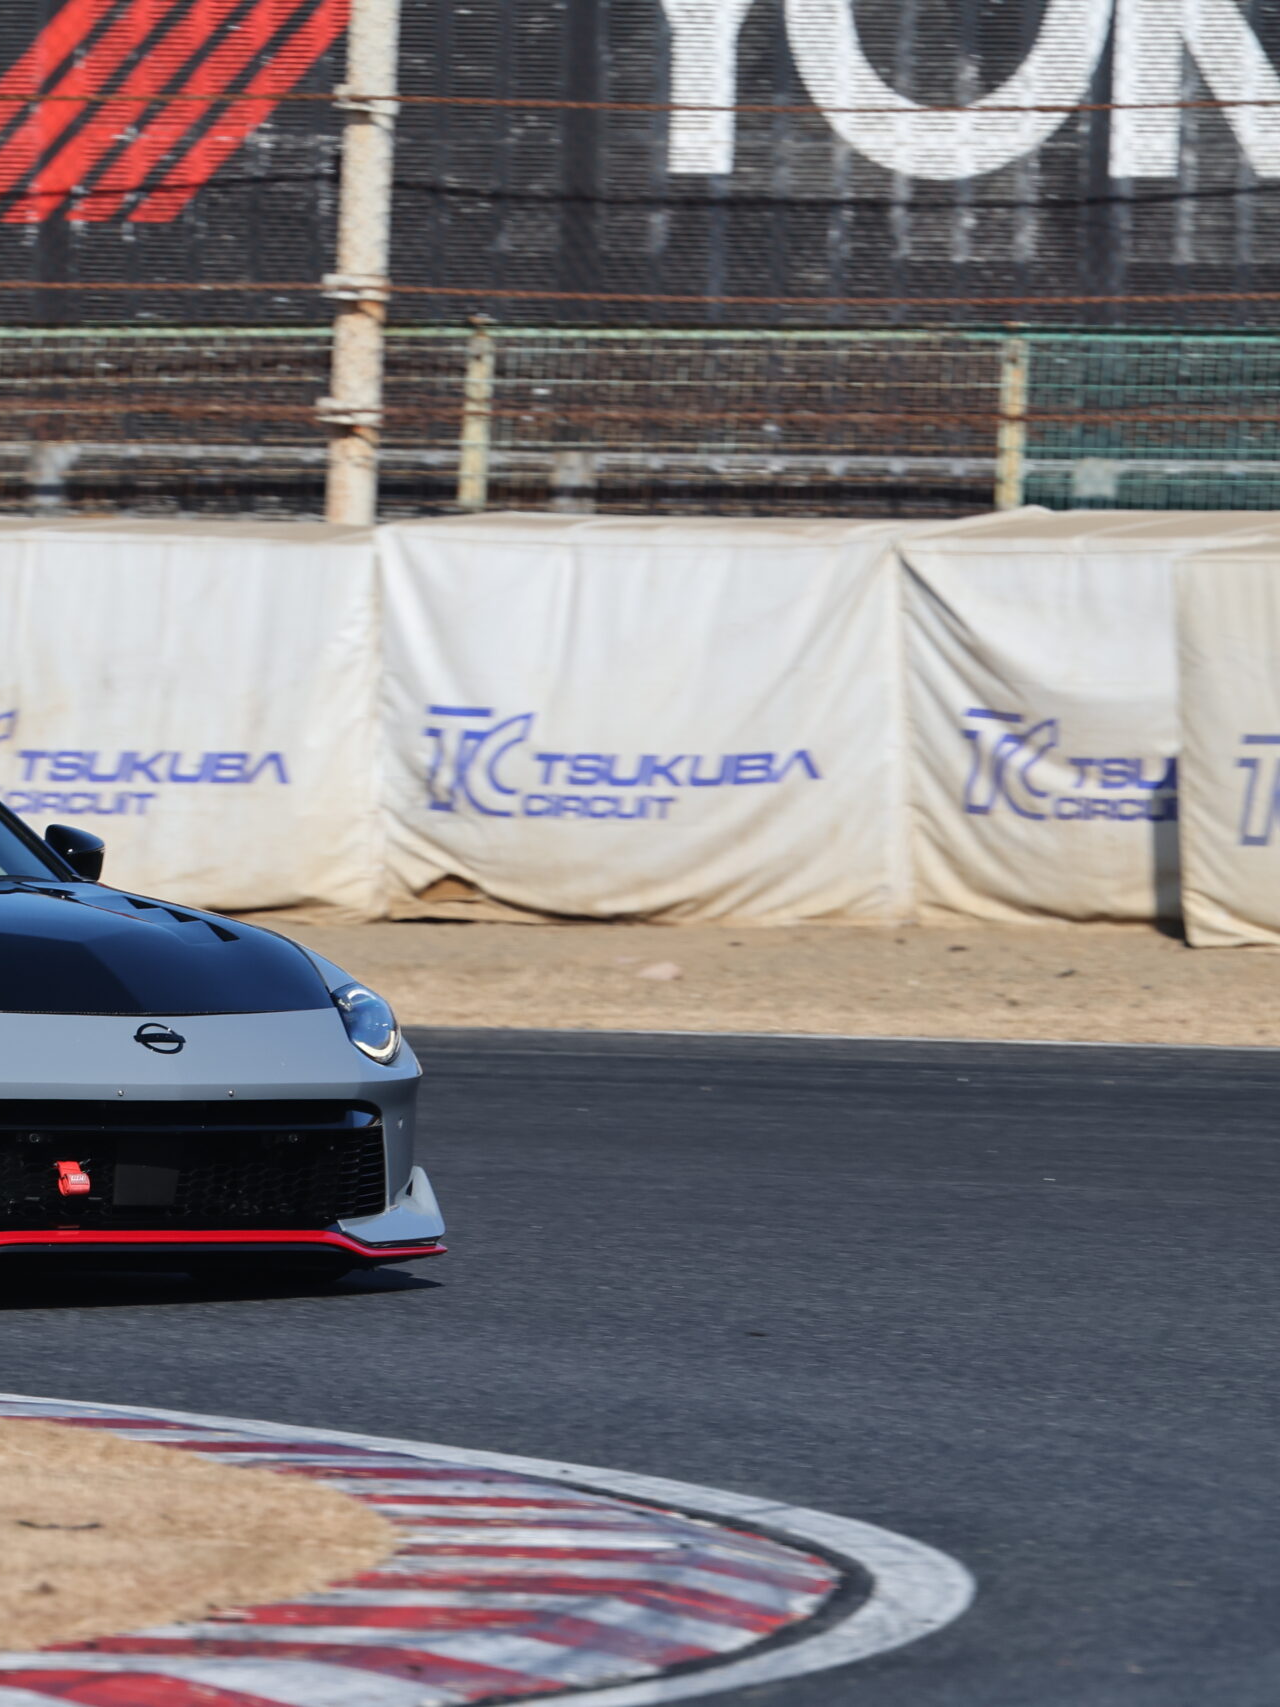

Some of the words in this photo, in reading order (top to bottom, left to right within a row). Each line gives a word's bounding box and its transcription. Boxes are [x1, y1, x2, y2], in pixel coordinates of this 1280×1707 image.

[16, 750, 290, 785] TSUKUBA
[534, 749, 824, 788] TSUKUBA
[8, 791, 156, 816] CIRCUIT
[523, 794, 678, 819] CIRCUIT
